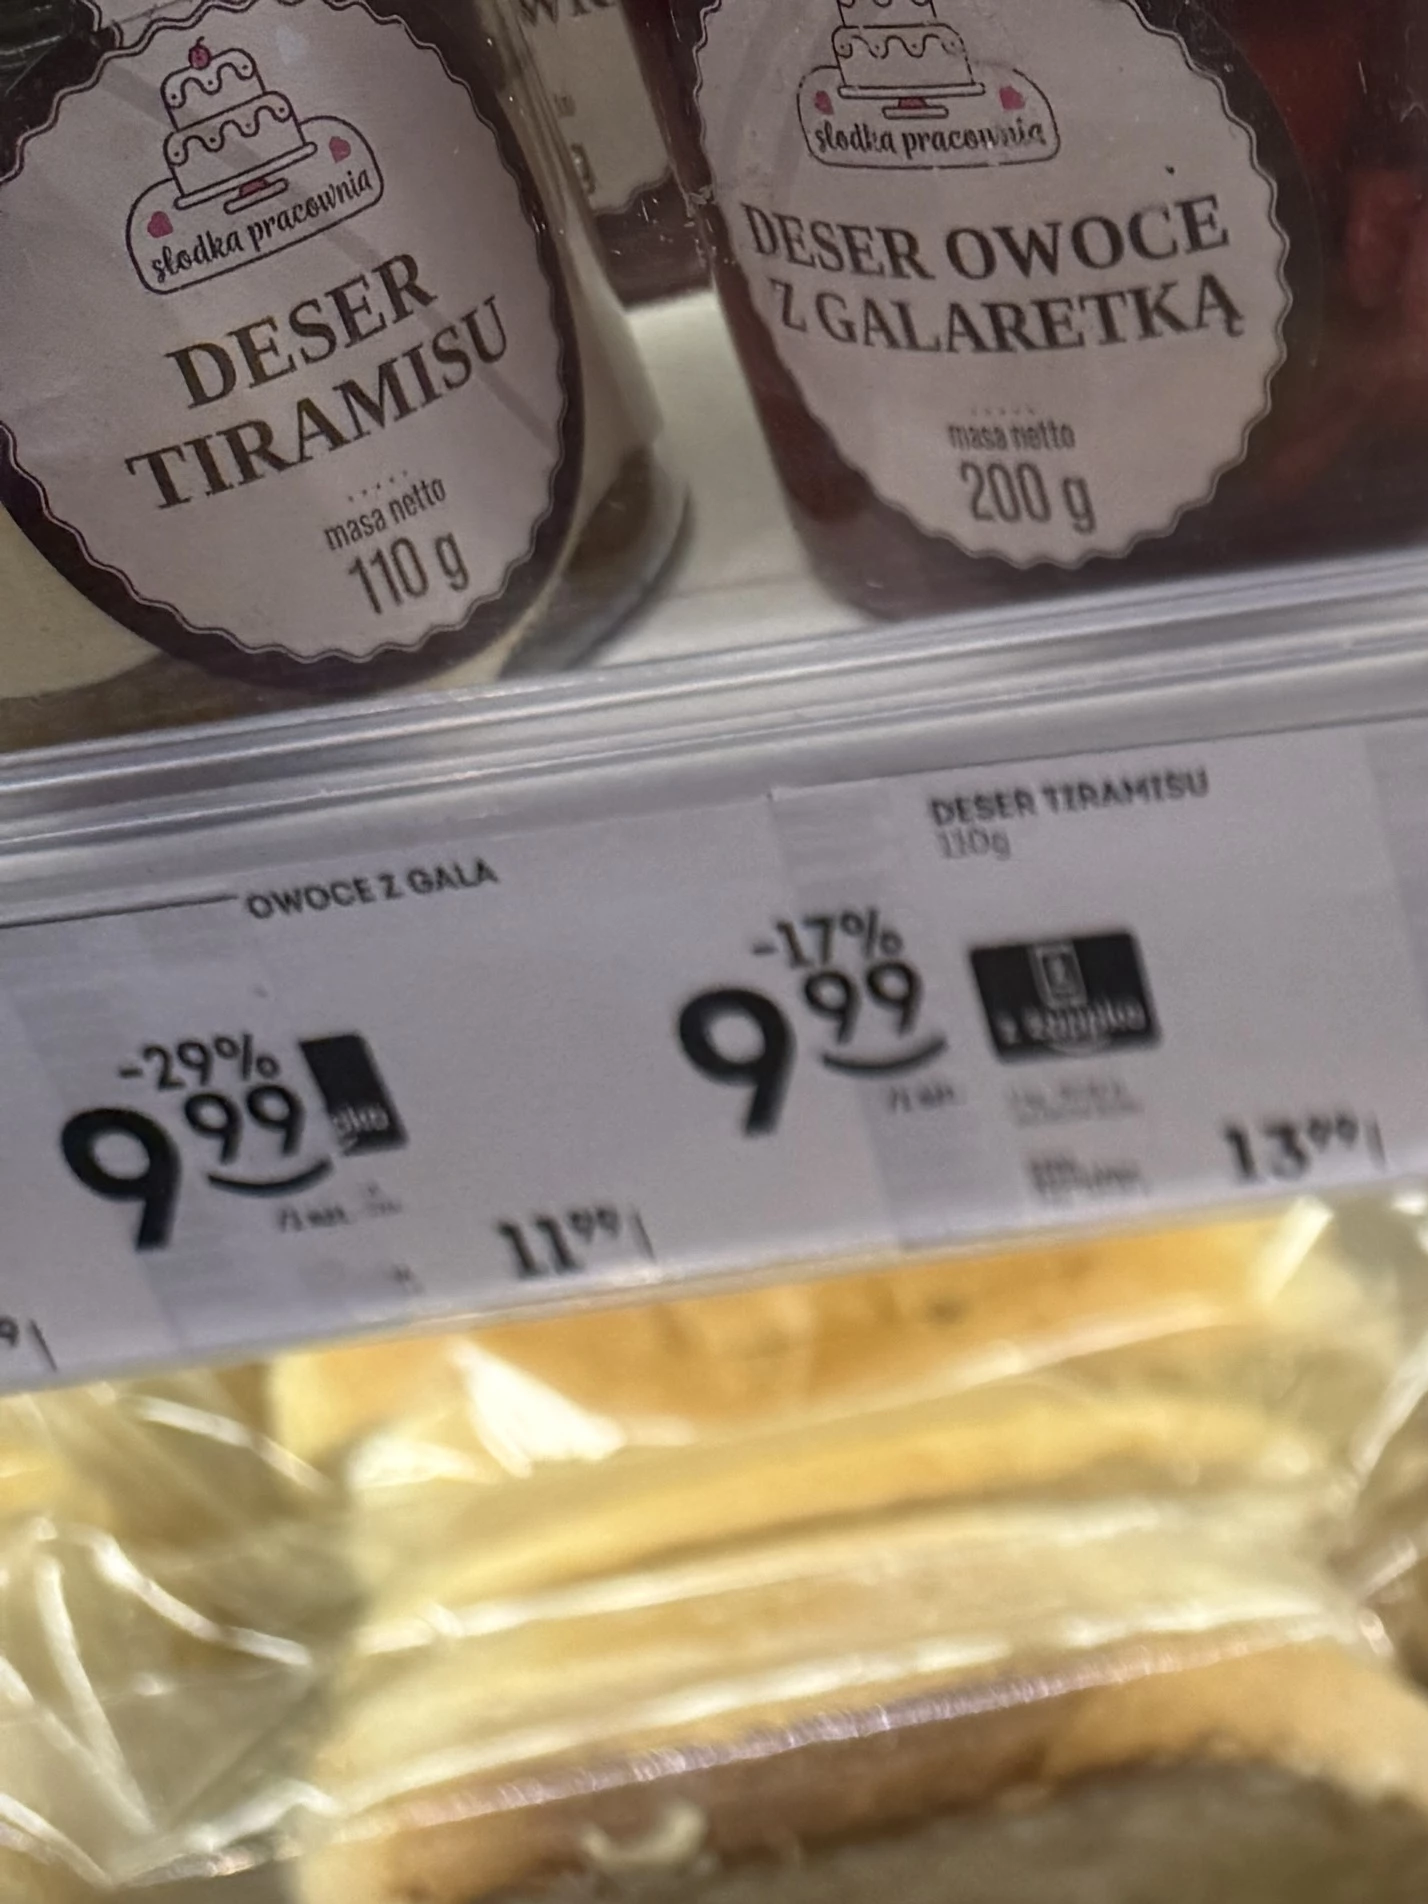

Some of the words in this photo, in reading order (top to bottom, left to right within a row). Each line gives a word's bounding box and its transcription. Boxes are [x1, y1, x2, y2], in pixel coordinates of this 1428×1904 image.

[250, 168, 373, 255] pracownia
[741, 202, 936, 281] DESER
[945, 193, 1230, 281] OWOCE
[165, 251, 438, 410] DESER
[770, 277, 808, 333] Z
[814, 273, 1246, 354] GALARETKĄ
[124, 295, 510, 511] TIRAMISU
[948, 420, 1001, 452] masa
[1004, 417, 1076, 451] netto
[324, 508, 388, 552] masa
[390, 475, 449, 528] netto
[960, 461, 1052, 524] 200
[1062, 474, 1098, 534] g
[347, 537, 428, 617] 110
[437, 531, 471, 590] g
[931, 790, 1039, 828] DESER
[1042, 768, 1210, 815] TIRAMISU
[246, 875, 377, 921] OWOCE
[378, 872, 405, 901] Z
[406, 856, 500, 896] GALA
[751, 906, 905, 972] -17%
[117, 1032, 281, 1091] -29%
